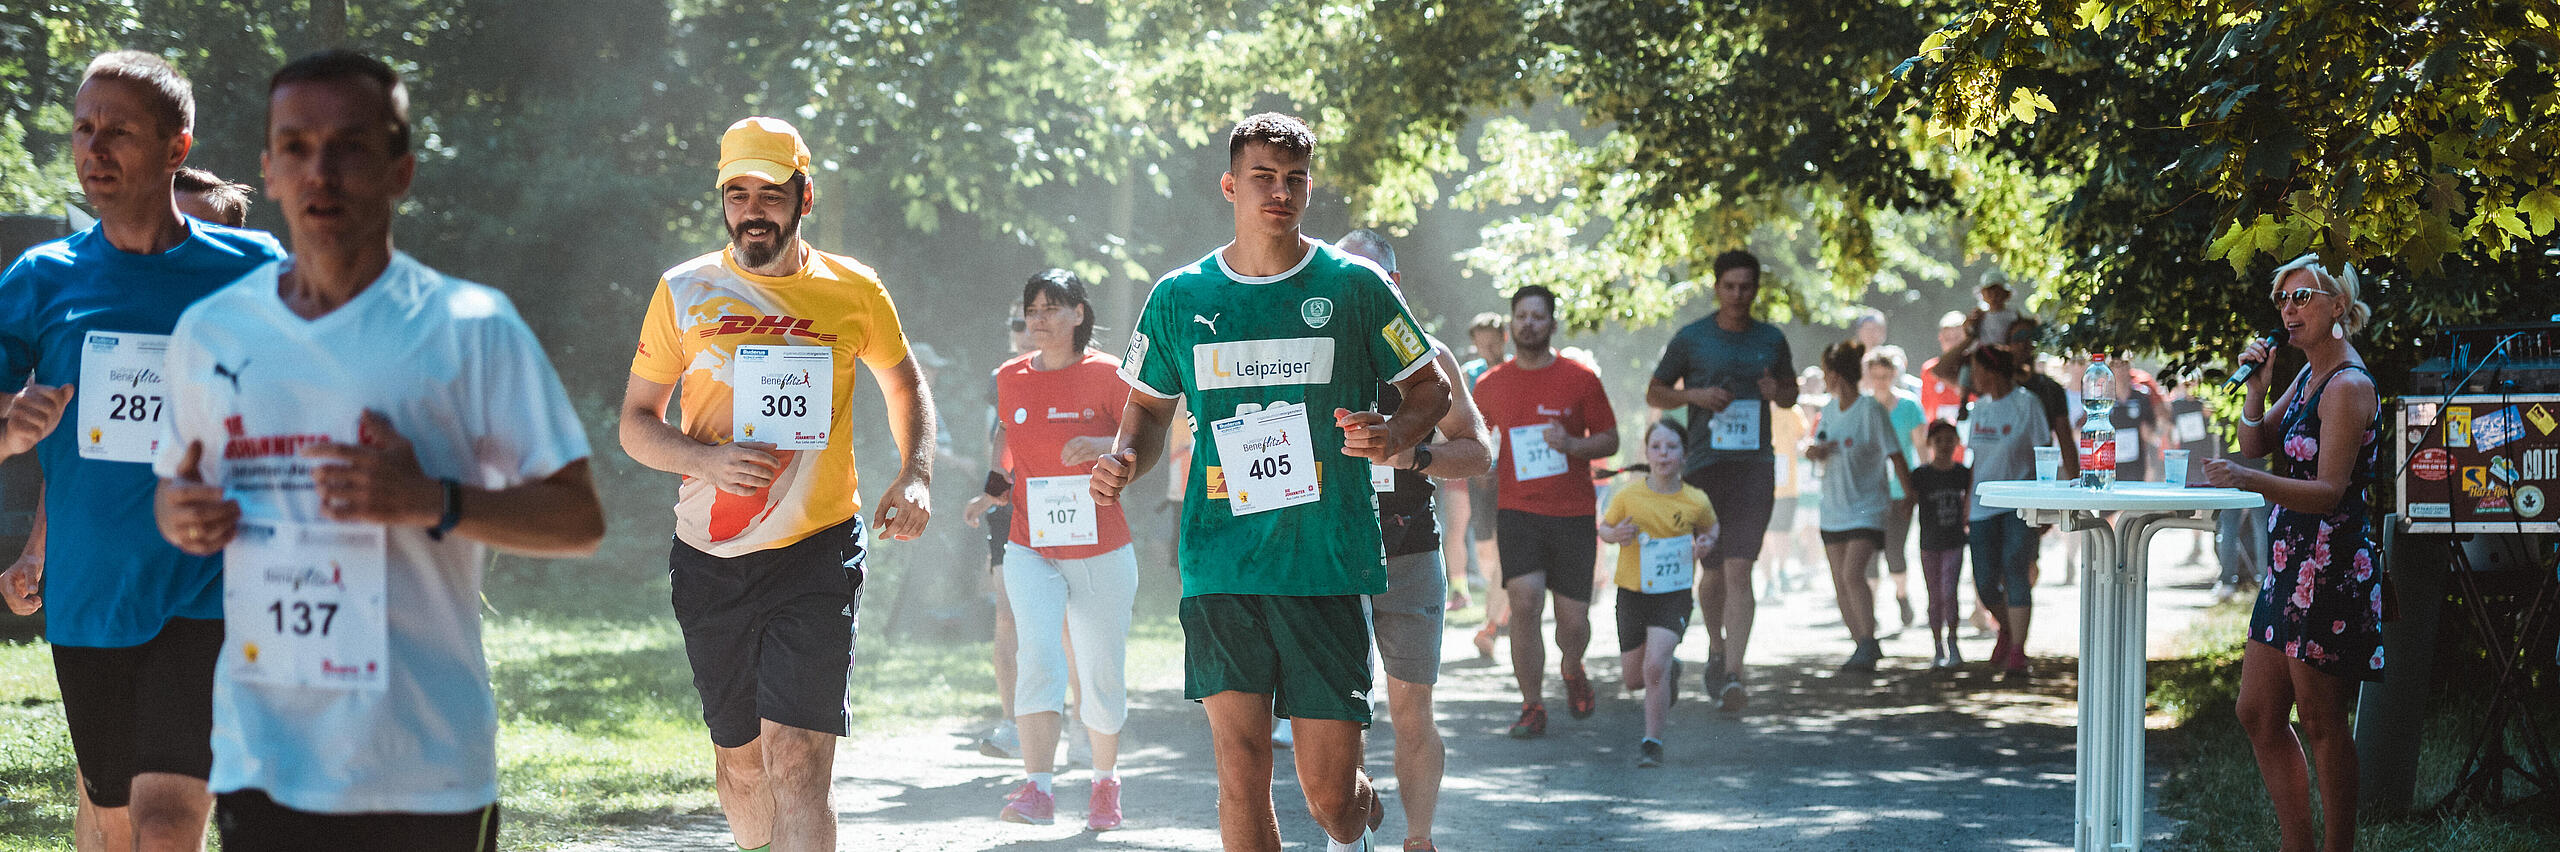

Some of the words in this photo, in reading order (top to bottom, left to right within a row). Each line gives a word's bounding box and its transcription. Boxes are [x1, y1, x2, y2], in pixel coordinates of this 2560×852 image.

[716, 315, 820, 339] DHL
[1236, 359, 1311, 379] Leipziger
[761, 373, 802, 390] Beneflitz
[110, 394, 163, 422] 287
[761, 395, 807, 417] 303
[1250, 454, 1292, 480] 405
[2545, 449, 2558, 480] IT
[1047, 509, 1077, 524] 107
[1656, 562, 1681, 577] 273
[268, 601, 339, 636] 137
